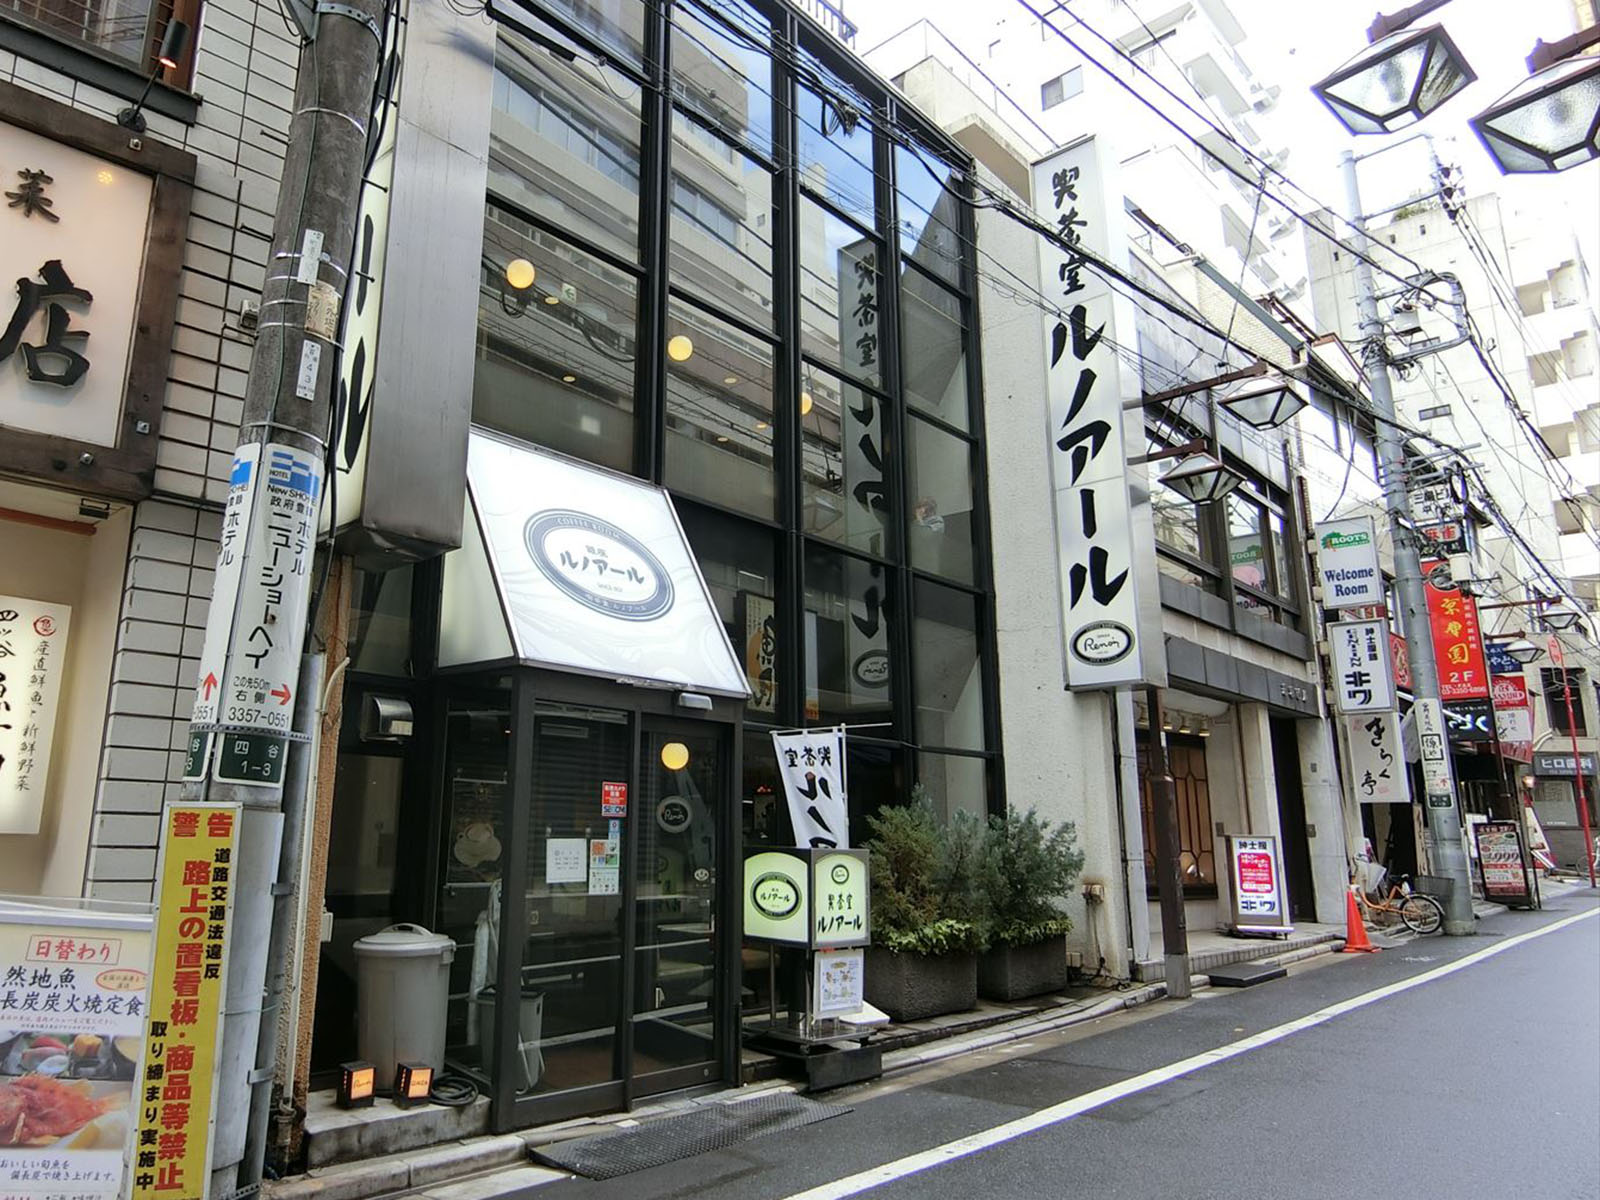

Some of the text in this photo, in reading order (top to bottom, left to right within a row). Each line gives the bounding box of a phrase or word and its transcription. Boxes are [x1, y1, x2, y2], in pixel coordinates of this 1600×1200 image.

[1052, 165, 1088, 296] 喫茶室
[0, 259, 93, 387] 店
[1050, 304, 1129, 611] ルノアール
[269, 469, 289, 479] HOTEL
[266, 484, 287, 496] New
[220, 511, 241, 567] ホテル
[291, 520, 313, 576] ホテル
[1331, 533, 1368, 546] ROOTS
[559, 550, 645, 585] ルノアール
[1324, 568, 1374, 582] Welcome
[245, 511, 293, 669] ニューショーヘイ
[1335, 584, 1369, 597] Room
[228, 706, 291, 728] 3357-0551
[234, 740, 280, 759] 四谷
[241, 760, 272, 777] 1-3
[173, 812, 233, 838] 警告
[760, 892, 791, 902] ルノアール
[204, 848, 232, 980] 道路交通法違反
[817, 914, 863, 934] ルノアール
[36, 940, 111, 962] 日替わり
[2, 965, 76, 990] 然地魚
[2, 990, 145, 1017] 長炭炭火焼定食
[154, 860, 212, 1191] 路上の置看板・商品等禁止
[136, 1021, 168, 1191] 取り締まり実施中
